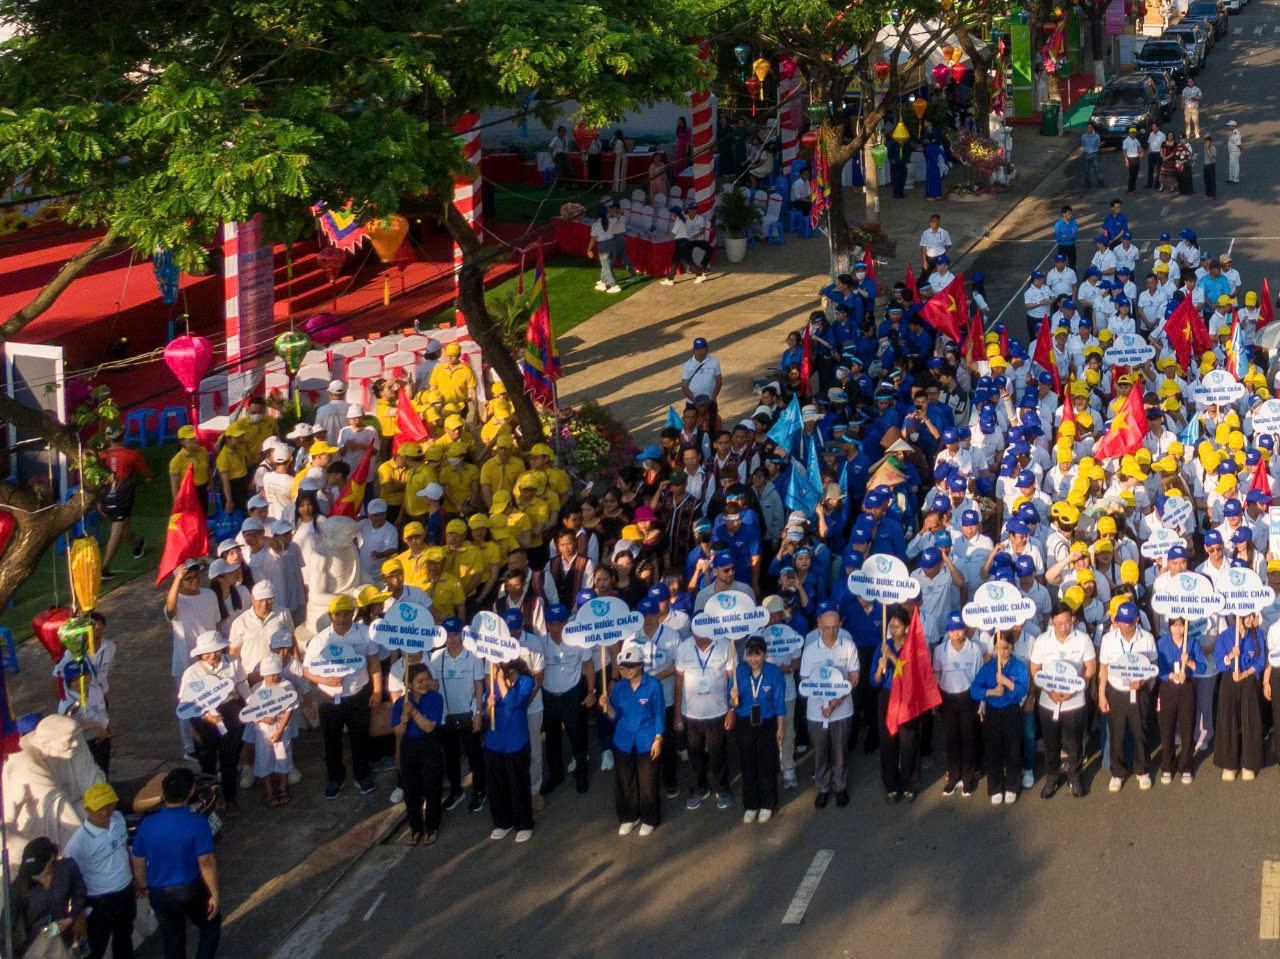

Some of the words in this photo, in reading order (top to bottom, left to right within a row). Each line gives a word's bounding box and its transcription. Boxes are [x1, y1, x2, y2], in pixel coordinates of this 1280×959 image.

[896, 579, 915, 589] CHÂN
[1251, 588, 1270, 597] CHÂN
[1201, 595, 1220, 604] CHÂN
[1011, 601, 1030, 610] CHÂN
[617, 614, 638, 625] CHÂN
[744, 610, 764, 620] CHÂN
[421, 626, 441, 637] CHÂN
